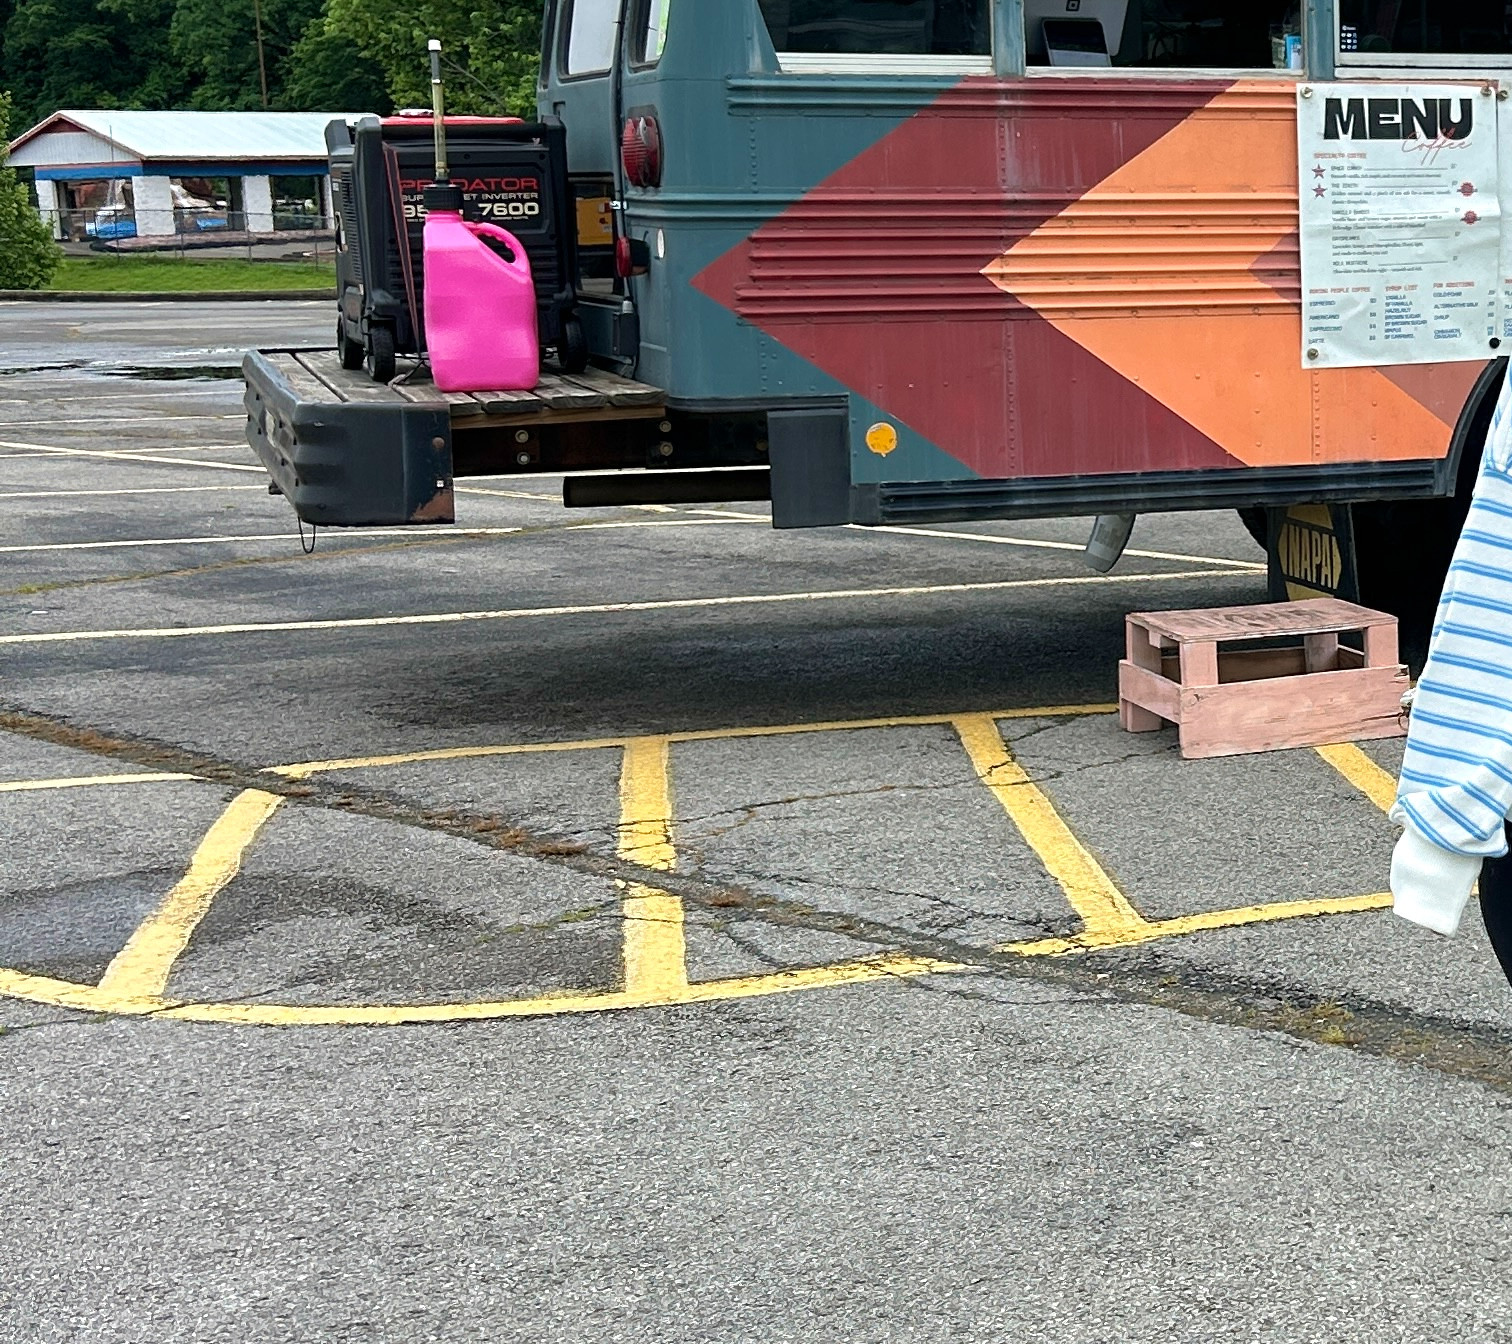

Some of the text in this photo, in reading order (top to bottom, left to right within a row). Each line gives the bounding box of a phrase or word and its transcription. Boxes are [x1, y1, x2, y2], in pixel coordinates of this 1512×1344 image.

[1323, 97, 1474, 141] MENU
[400, 178, 538, 192] PRDATOR
[481, 192, 539, 201] INVERTER
[478, 202, 540, 216] 7600
[1288, 523, 1333, 588] NAPA
